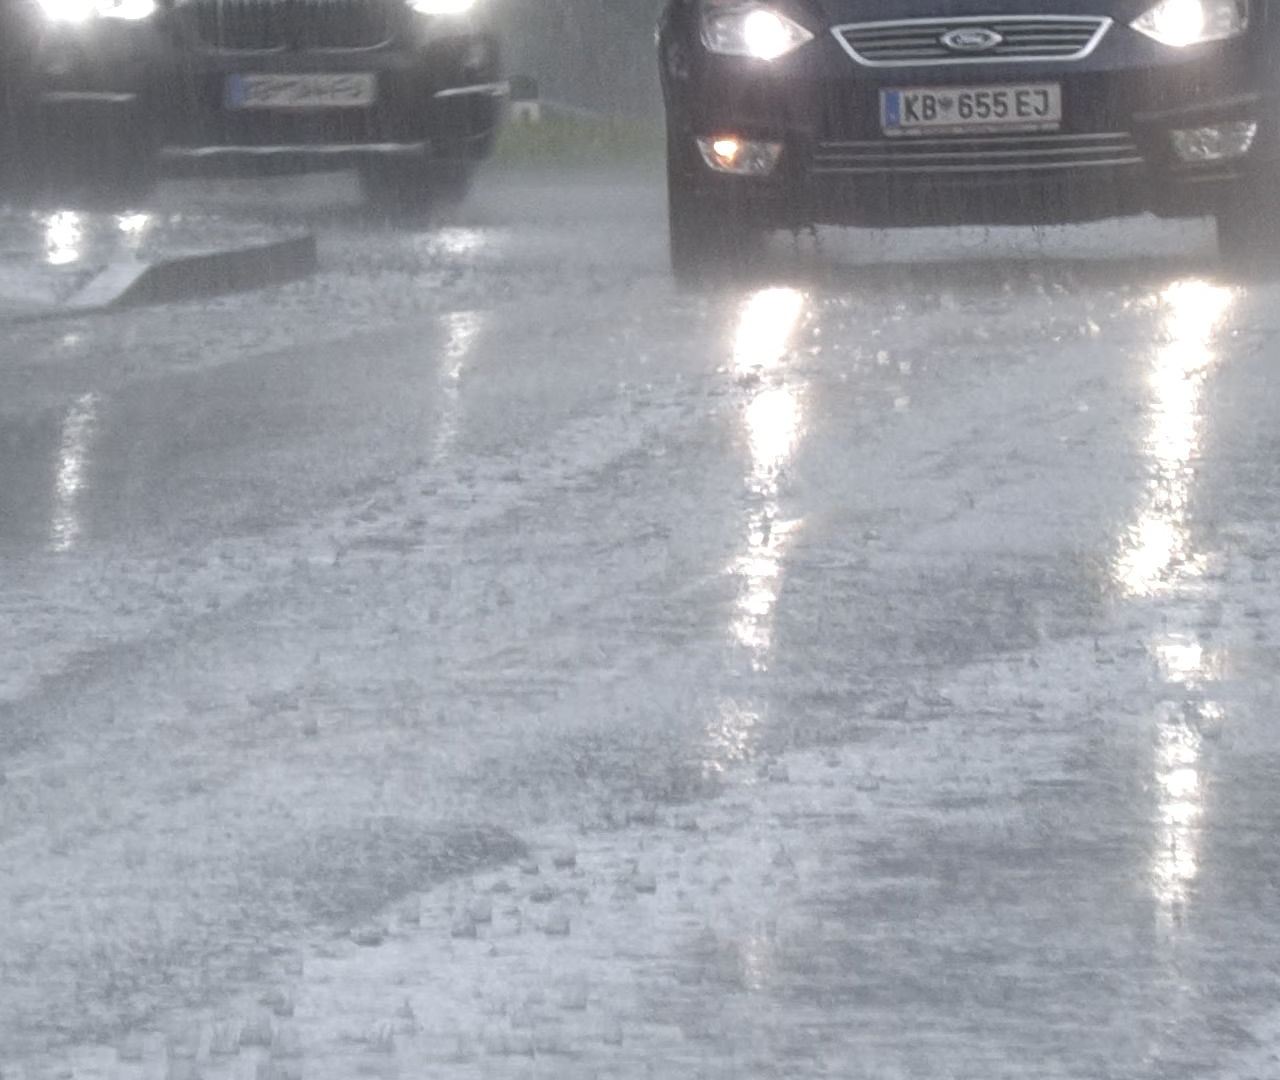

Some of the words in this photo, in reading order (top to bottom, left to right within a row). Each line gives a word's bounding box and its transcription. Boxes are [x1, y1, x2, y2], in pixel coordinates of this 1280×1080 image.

[904, 94, 937, 121] KB
[958, 93, 1008, 119] 655
[1015, 89, 1049, 117] EJ
